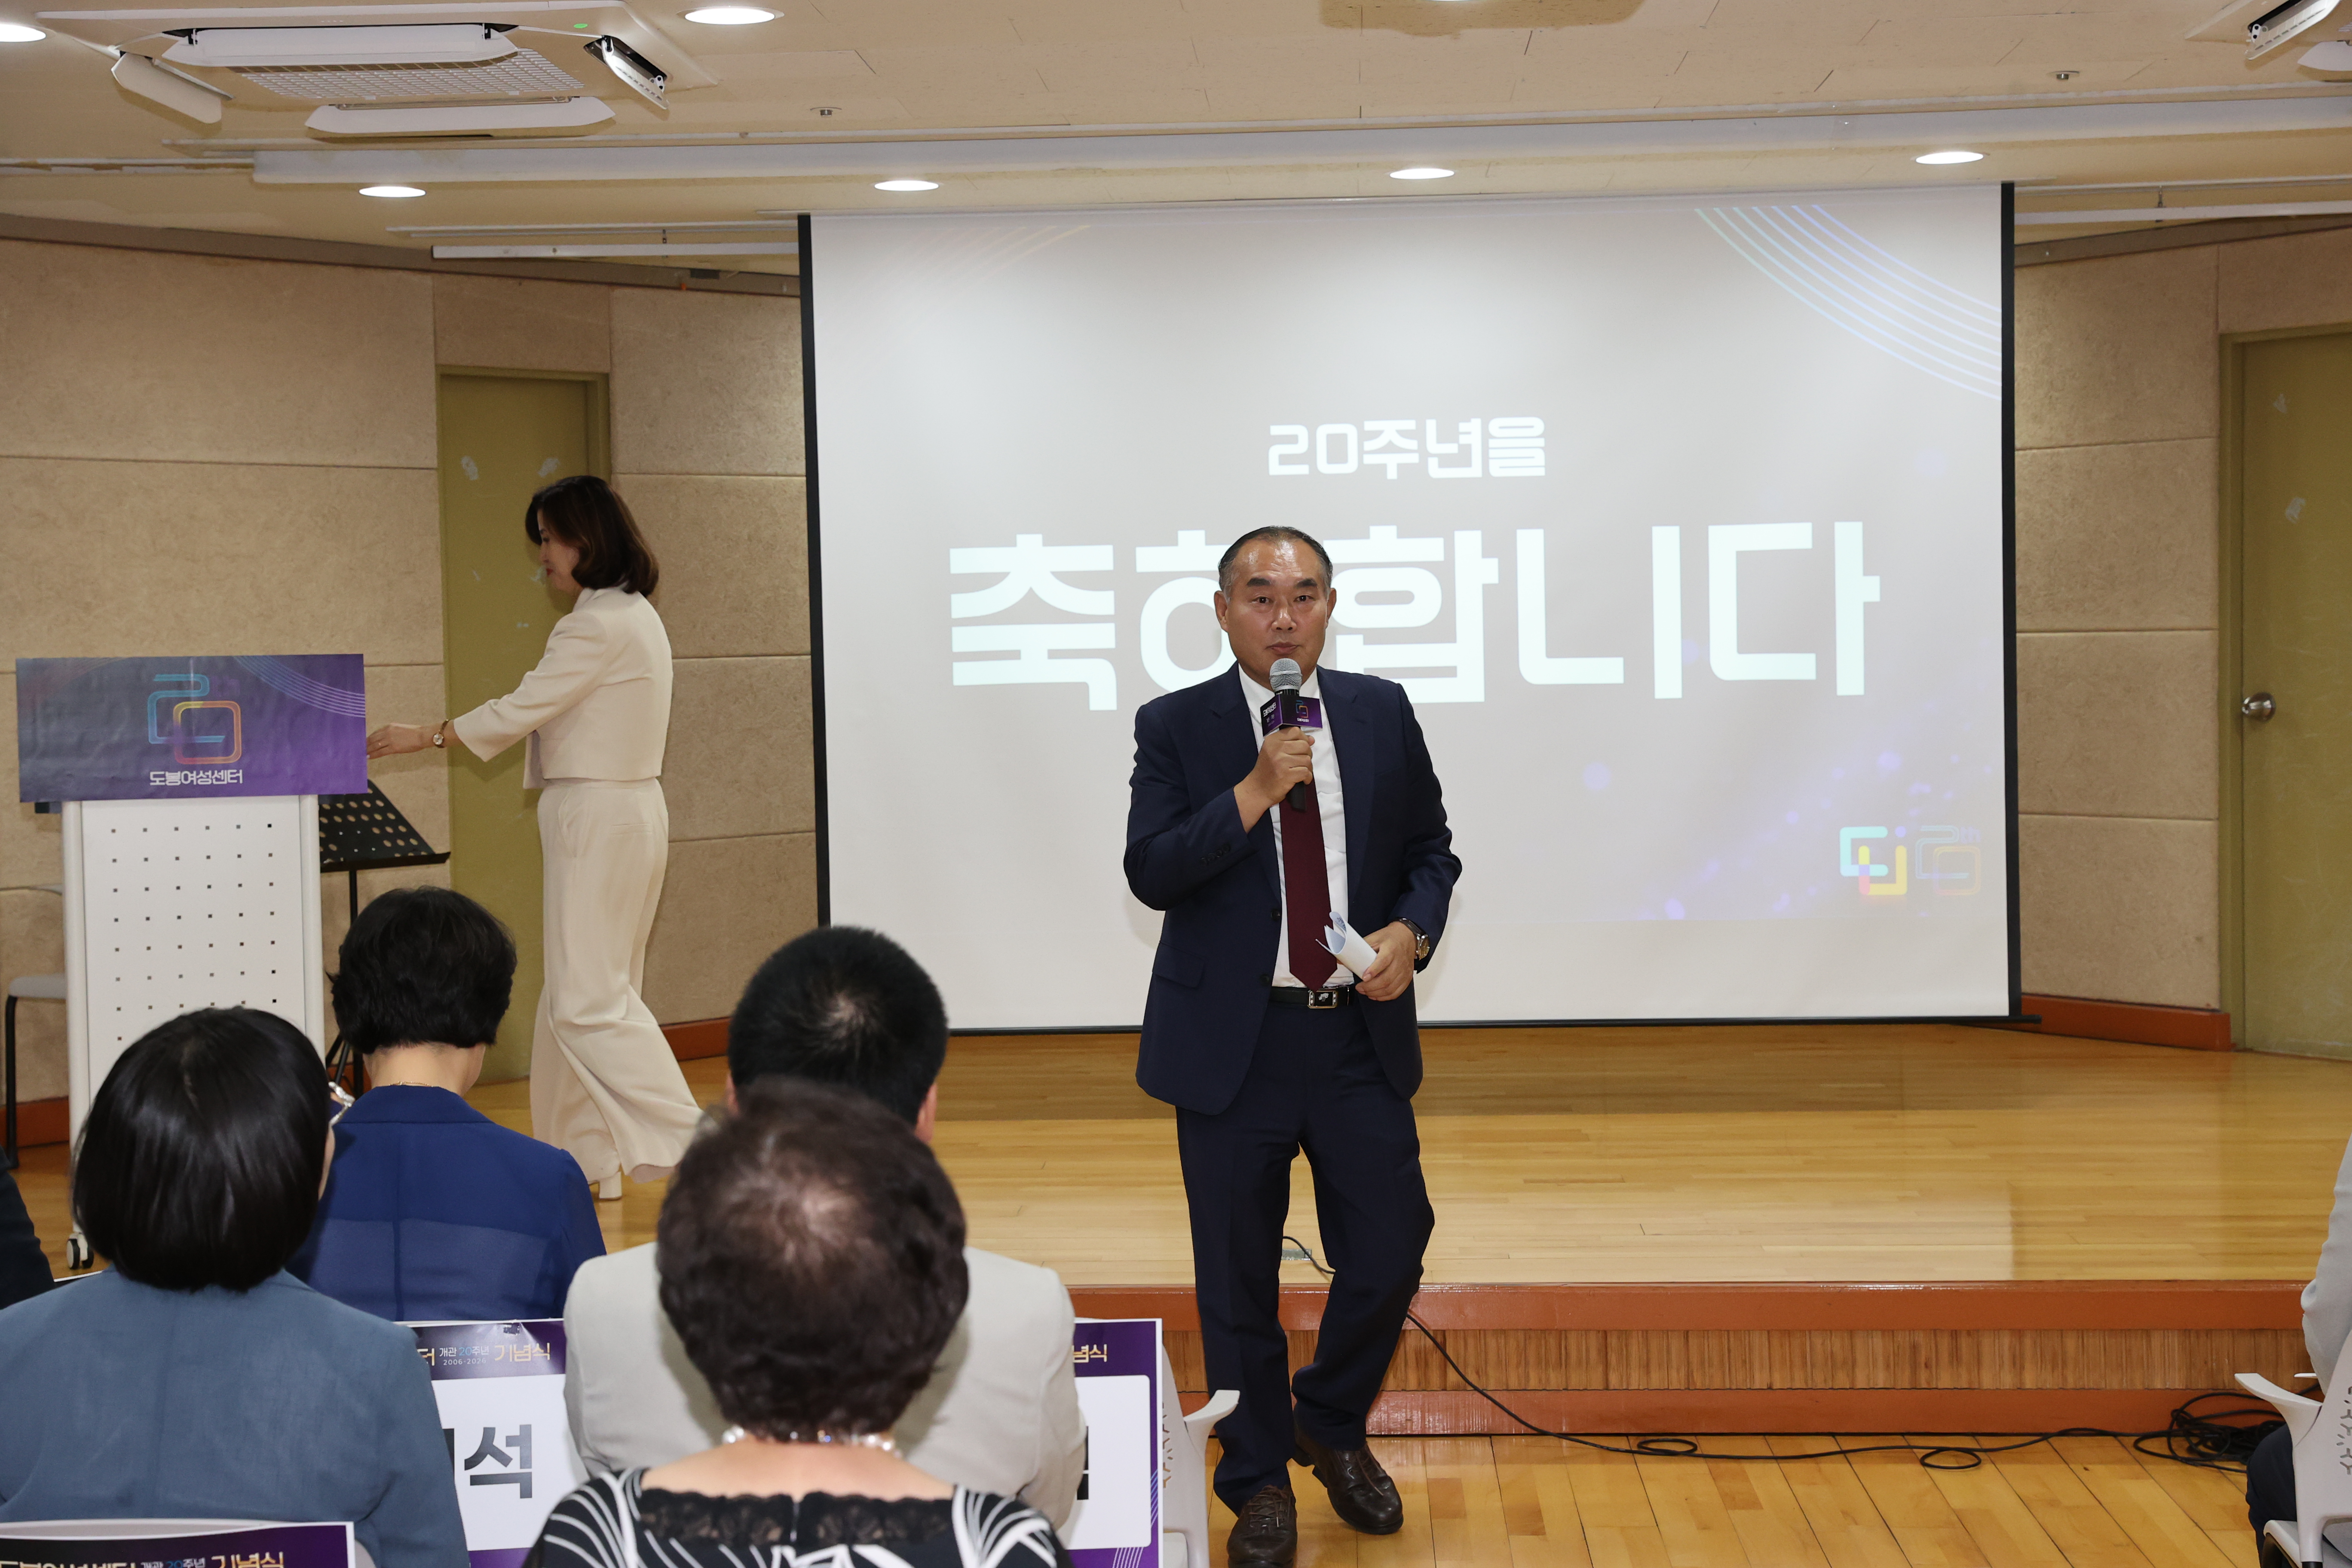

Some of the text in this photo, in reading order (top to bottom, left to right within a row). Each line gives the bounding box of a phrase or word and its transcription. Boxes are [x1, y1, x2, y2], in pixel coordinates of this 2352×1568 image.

[1268, 416, 1546, 480] 20주년을
[150, 769, 243, 786] 도봉여성센터
[439, 1348, 456, 1357] 개관
[459, 1345, 489, 1356] 20주년
[494, 1342, 551, 1362] 기념식
[1072, 1344, 1107, 1363] 념식
